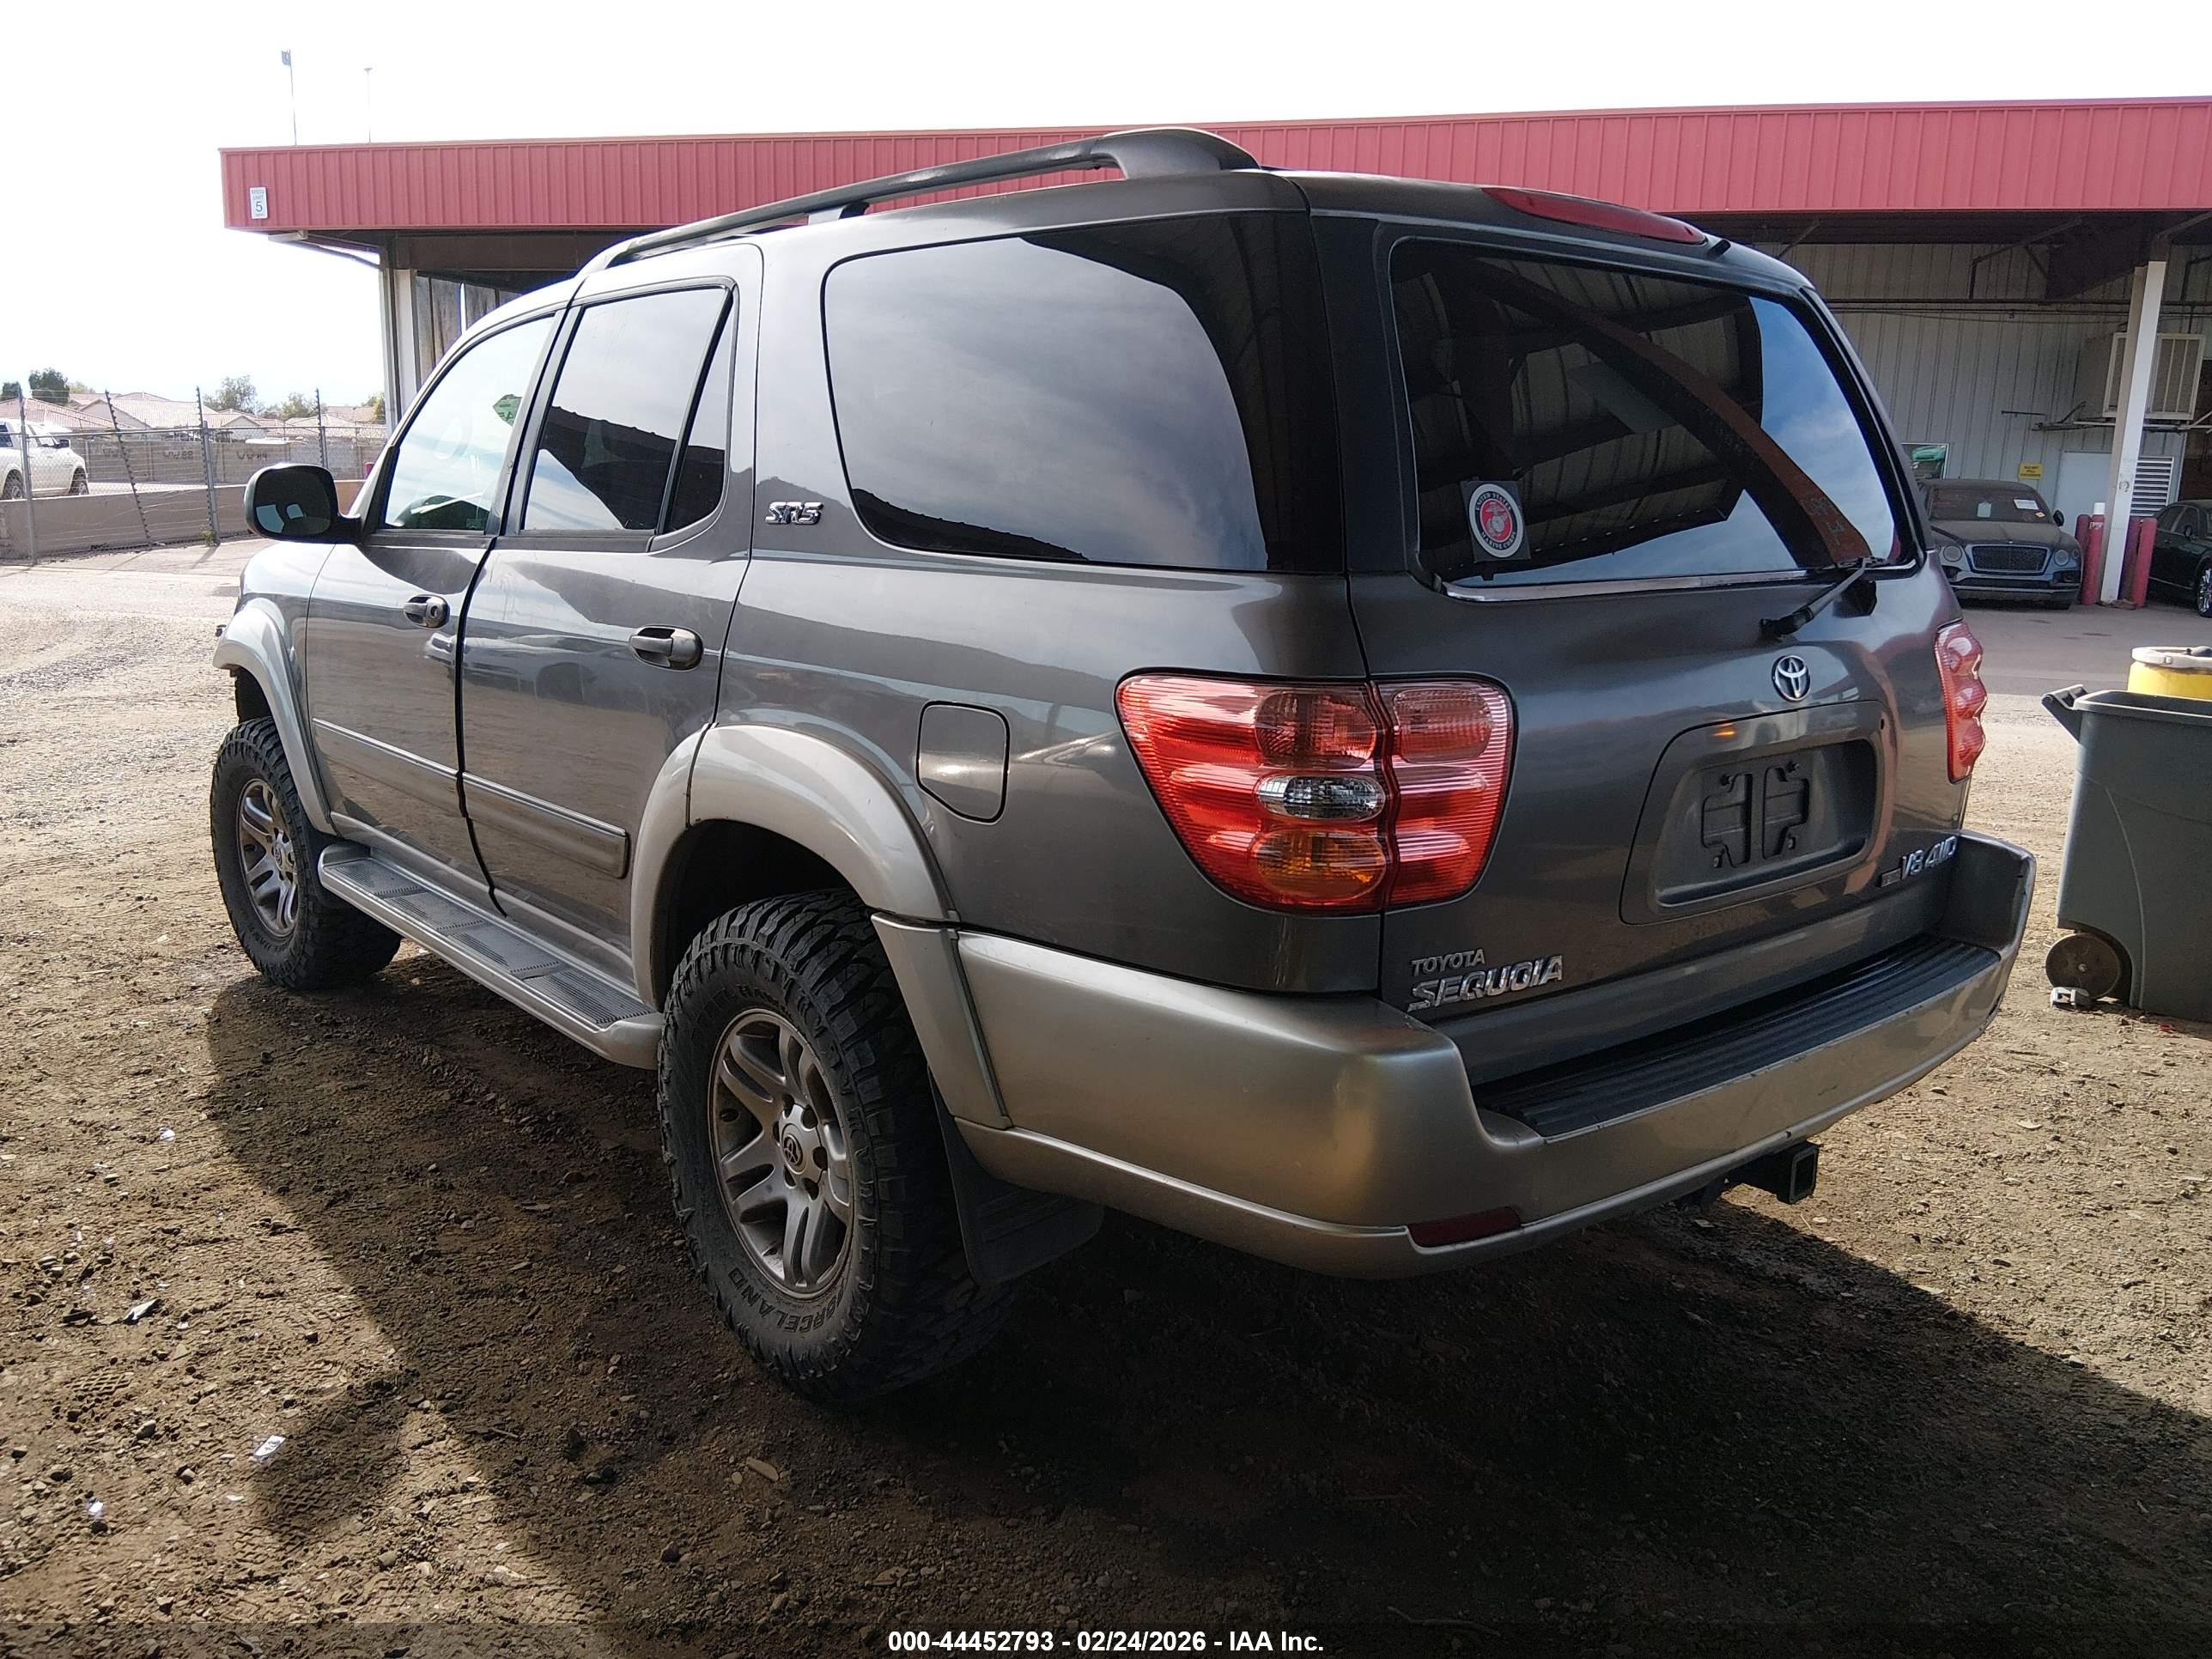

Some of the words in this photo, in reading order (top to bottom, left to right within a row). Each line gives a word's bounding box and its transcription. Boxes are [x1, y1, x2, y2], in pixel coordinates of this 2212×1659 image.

[255, 201, 263, 212] 5
[765, 501, 823, 526] SR5
[1901, 849, 1923, 880] V8
[1411, 947, 1486, 976] TOYOTA
[1407, 954, 1563, 1013] SEQUOIA
